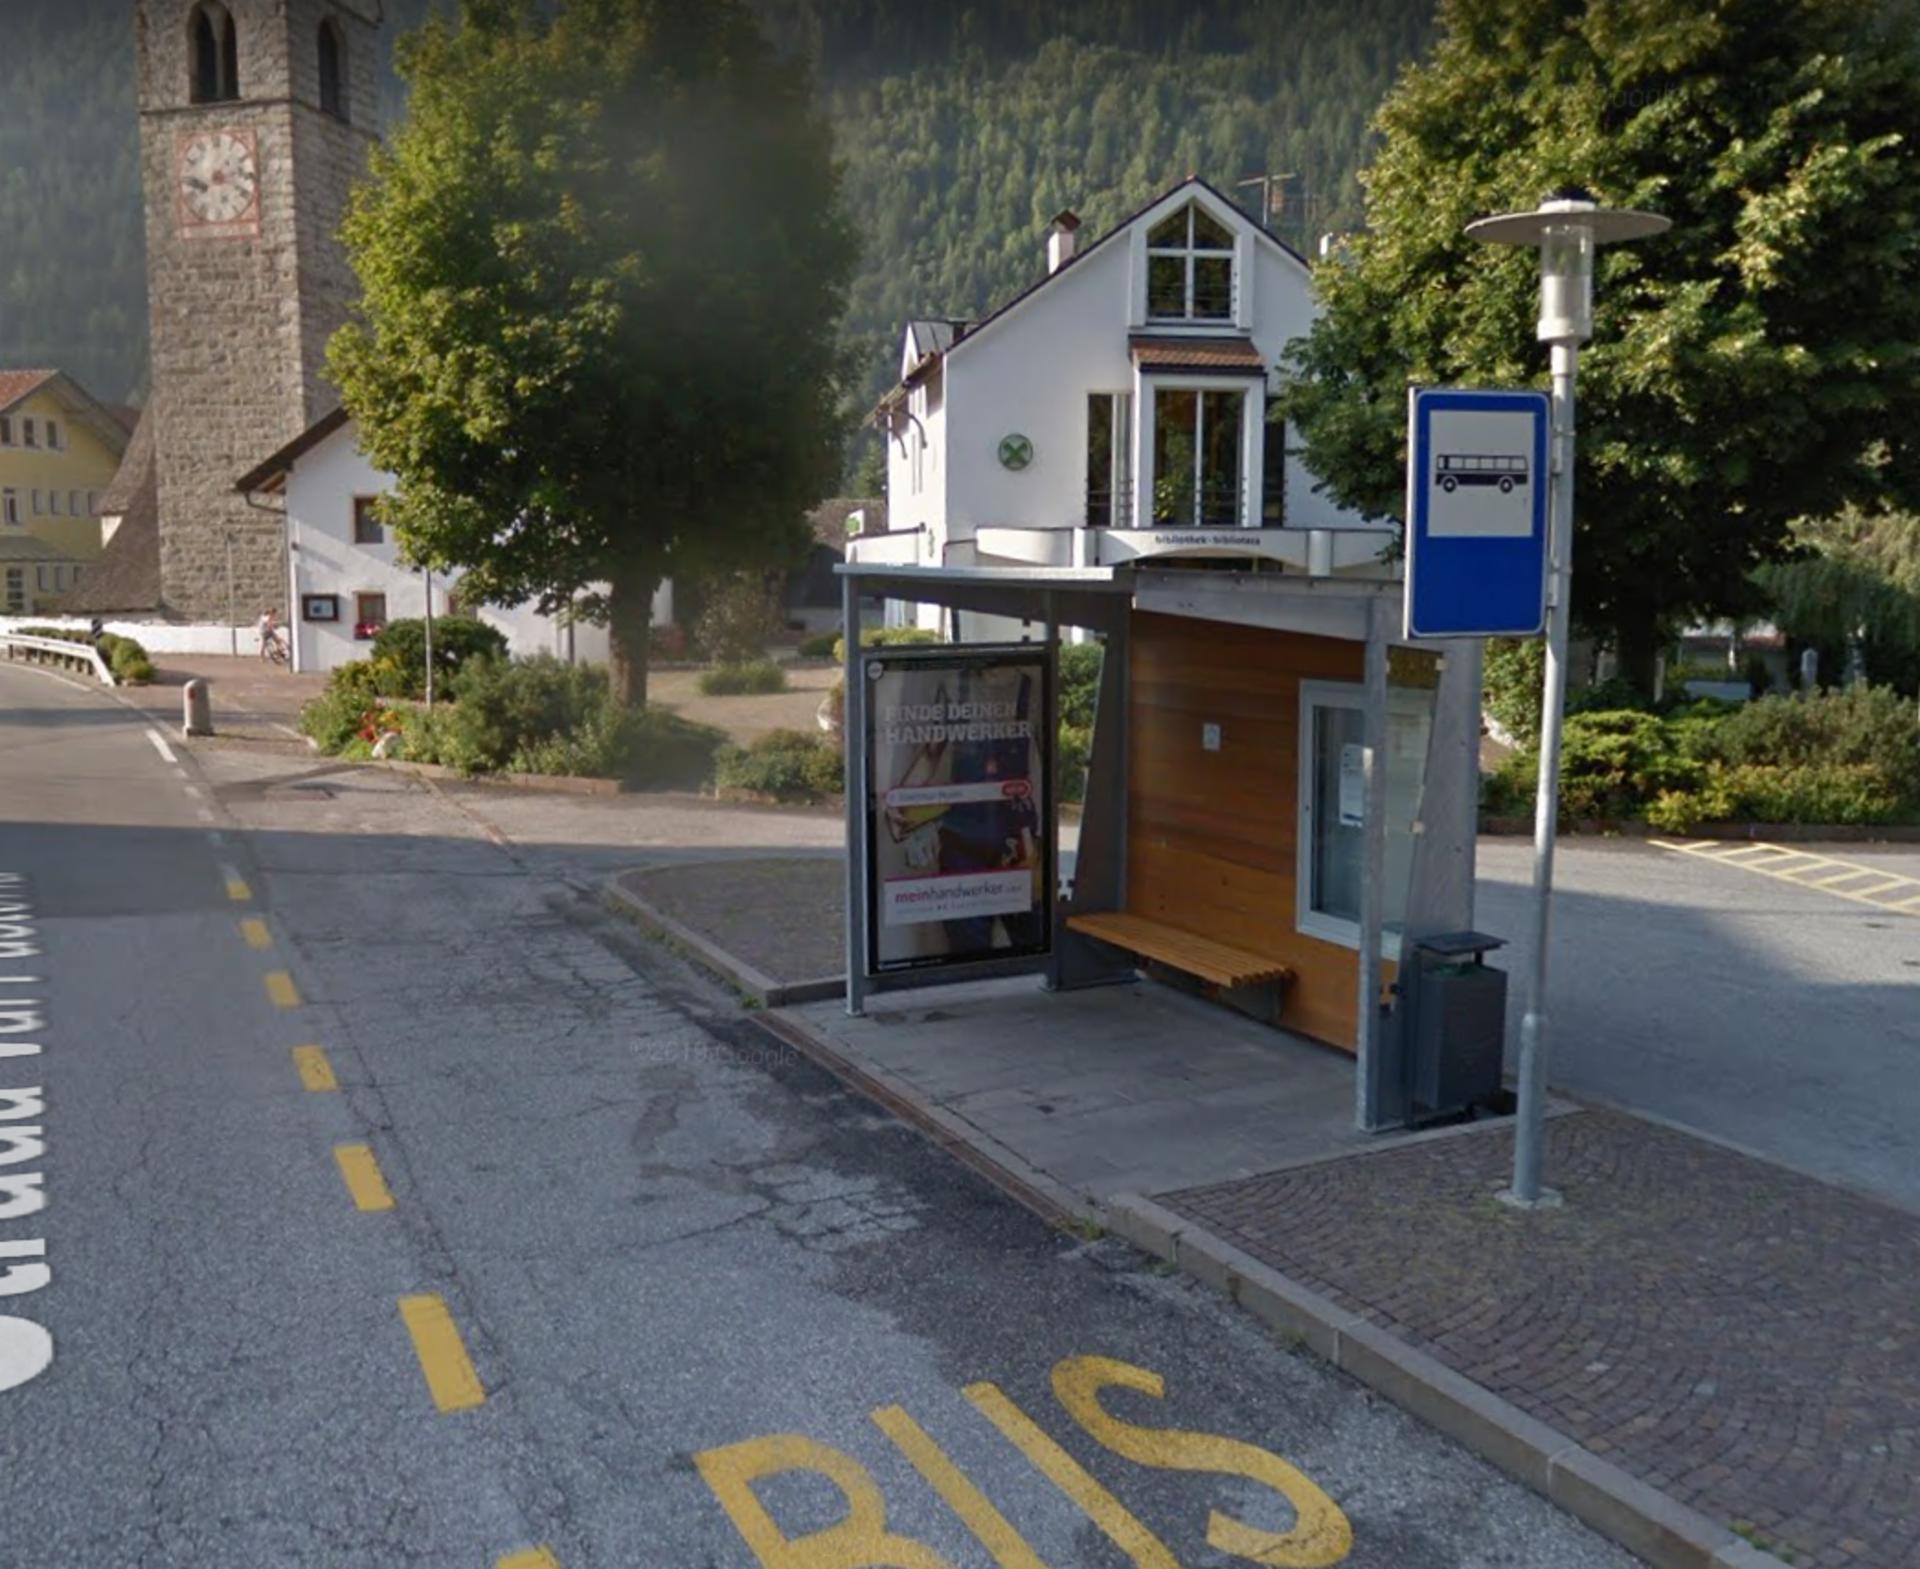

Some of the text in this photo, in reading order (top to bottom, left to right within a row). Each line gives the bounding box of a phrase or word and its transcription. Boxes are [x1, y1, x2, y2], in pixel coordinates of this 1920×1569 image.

[884, 701, 1018, 722] FINDE DEINEN
[884, 720, 1032, 744] HANDWERKER
[691, 1354, 1352, 1569] BUS
